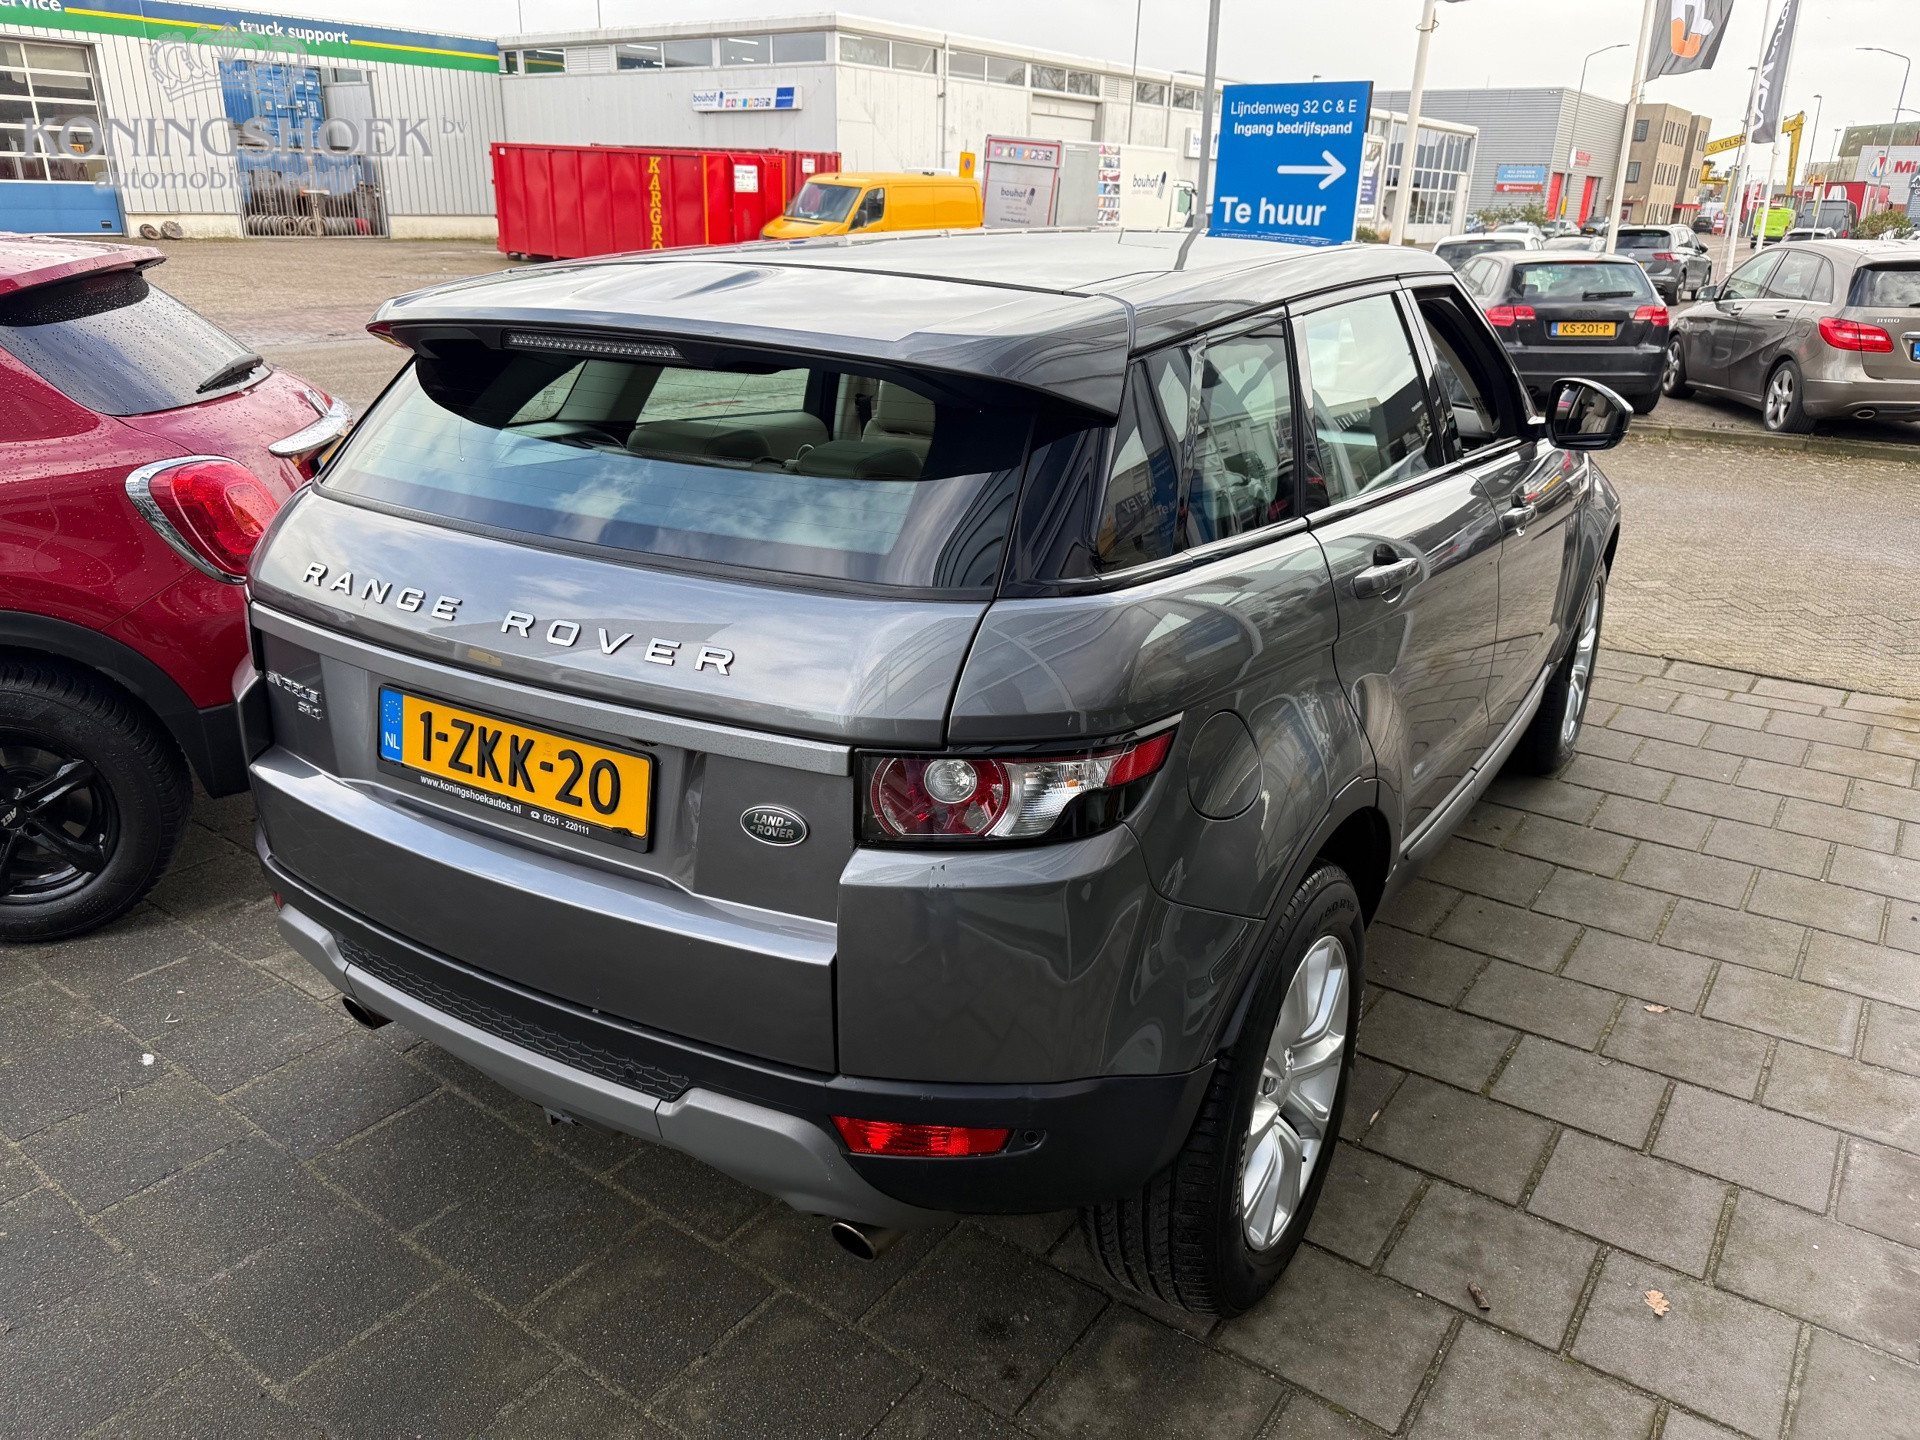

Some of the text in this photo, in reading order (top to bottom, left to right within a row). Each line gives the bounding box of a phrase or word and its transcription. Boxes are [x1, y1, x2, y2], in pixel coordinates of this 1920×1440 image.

[240, 19, 349, 45] truck support
[1231, 99, 1357, 117] Lijndenweg 32 C & E
[1234, 121, 1352, 137] Ingang bedrijfspand
[1894, 161, 1917, 173] Mi
[1133, 174, 1159, 188] bouhof
[1001, 187, 1027, 198] bouhof
[1220, 196, 1327, 226] Te huur
[1562, 324, 1610, 334] KS-201-P
[302, 561, 735, 676] RANGE ROVER
[385, 732, 400, 750] NL
[420, 711, 621, 816] 1-ZKK-20
[420, 775, 522, 814] www.koningshoekautos.nl
[1, 807, 17, 827] AEZ
[543, 813, 560, 826] 0251
[565, 821, 589, 835] 220111
[753, 813, 784, 827] LAND
[756, 825, 795, 839] ROVER
